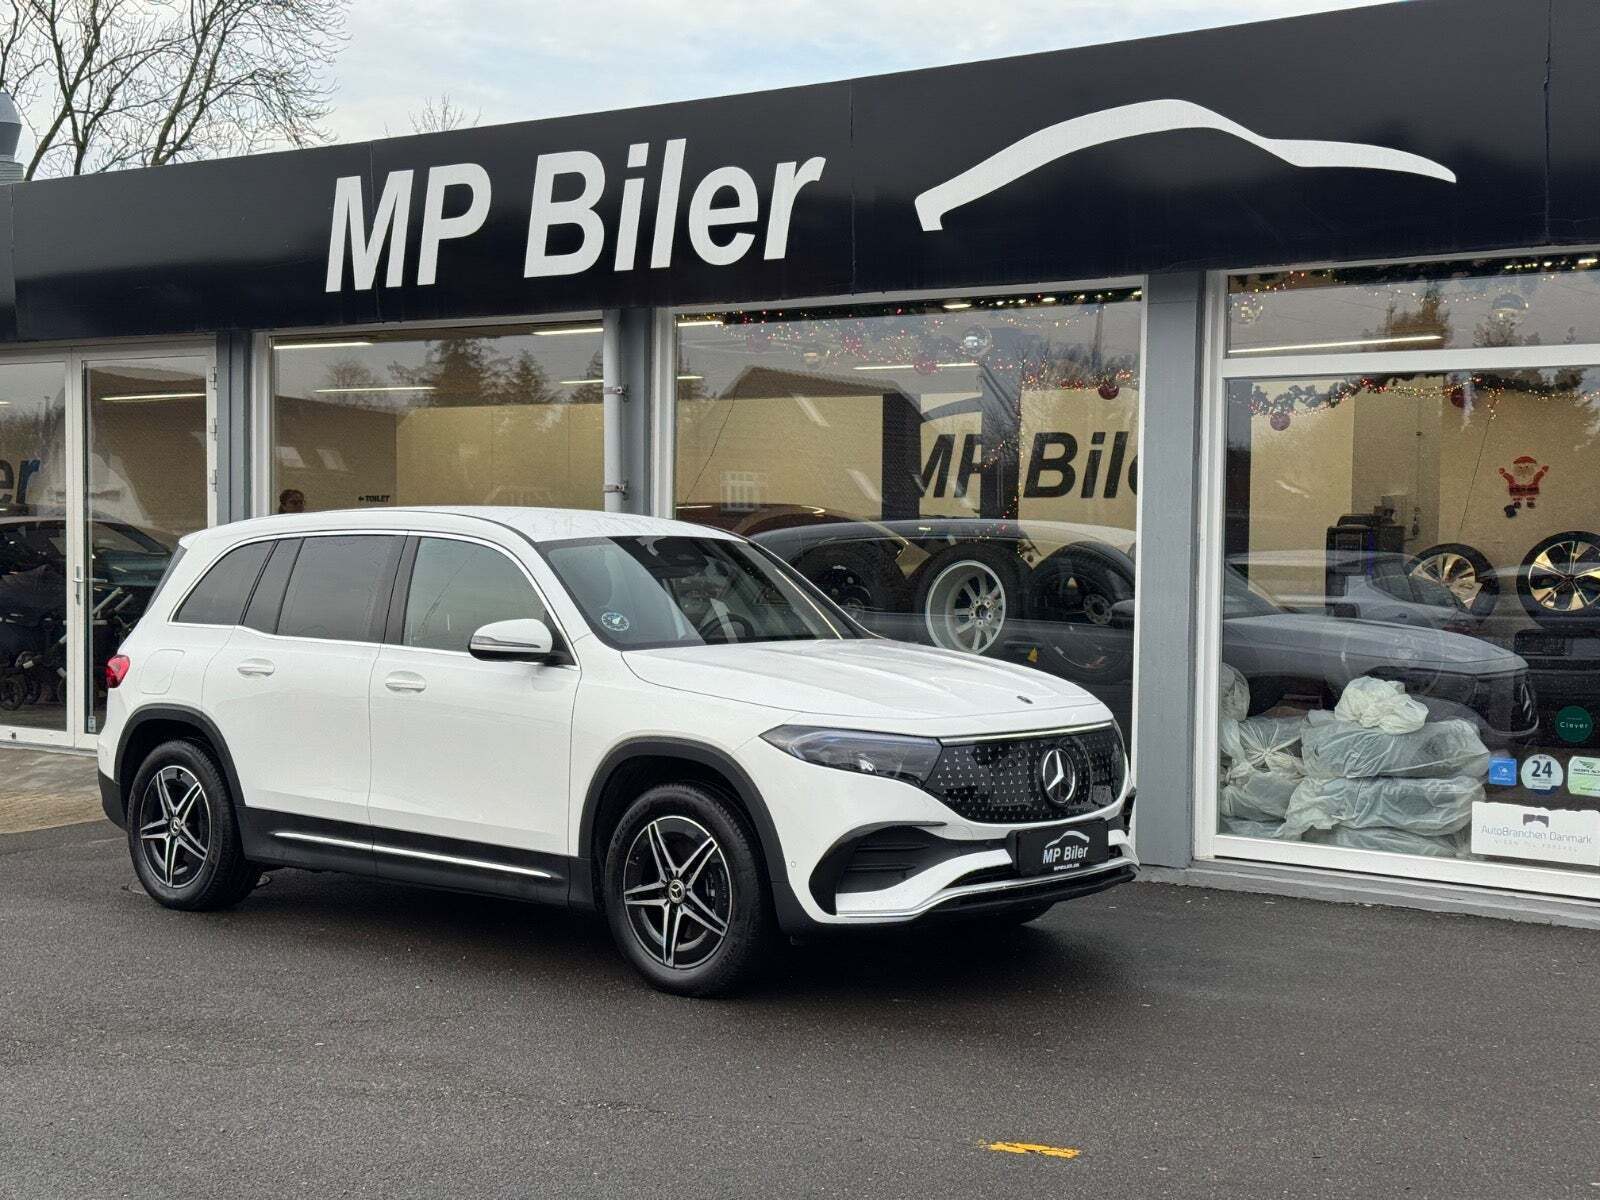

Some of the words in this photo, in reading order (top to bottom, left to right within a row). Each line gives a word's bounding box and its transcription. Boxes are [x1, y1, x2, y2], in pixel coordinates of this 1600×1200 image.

[325, 163, 492, 293] MP
[524, 138, 827, 278] Biler
[1023, 431, 1138, 499] Bil
[1560, 721, 1588, 729] Clever
[1531, 760, 1553, 778] 24
[1481, 825, 1547, 840] AutoBranchen
[1549, 831, 1592, 844] Danmark
[1043, 847, 1061, 864] MP
[1064, 845, 1088, 861] Biler
